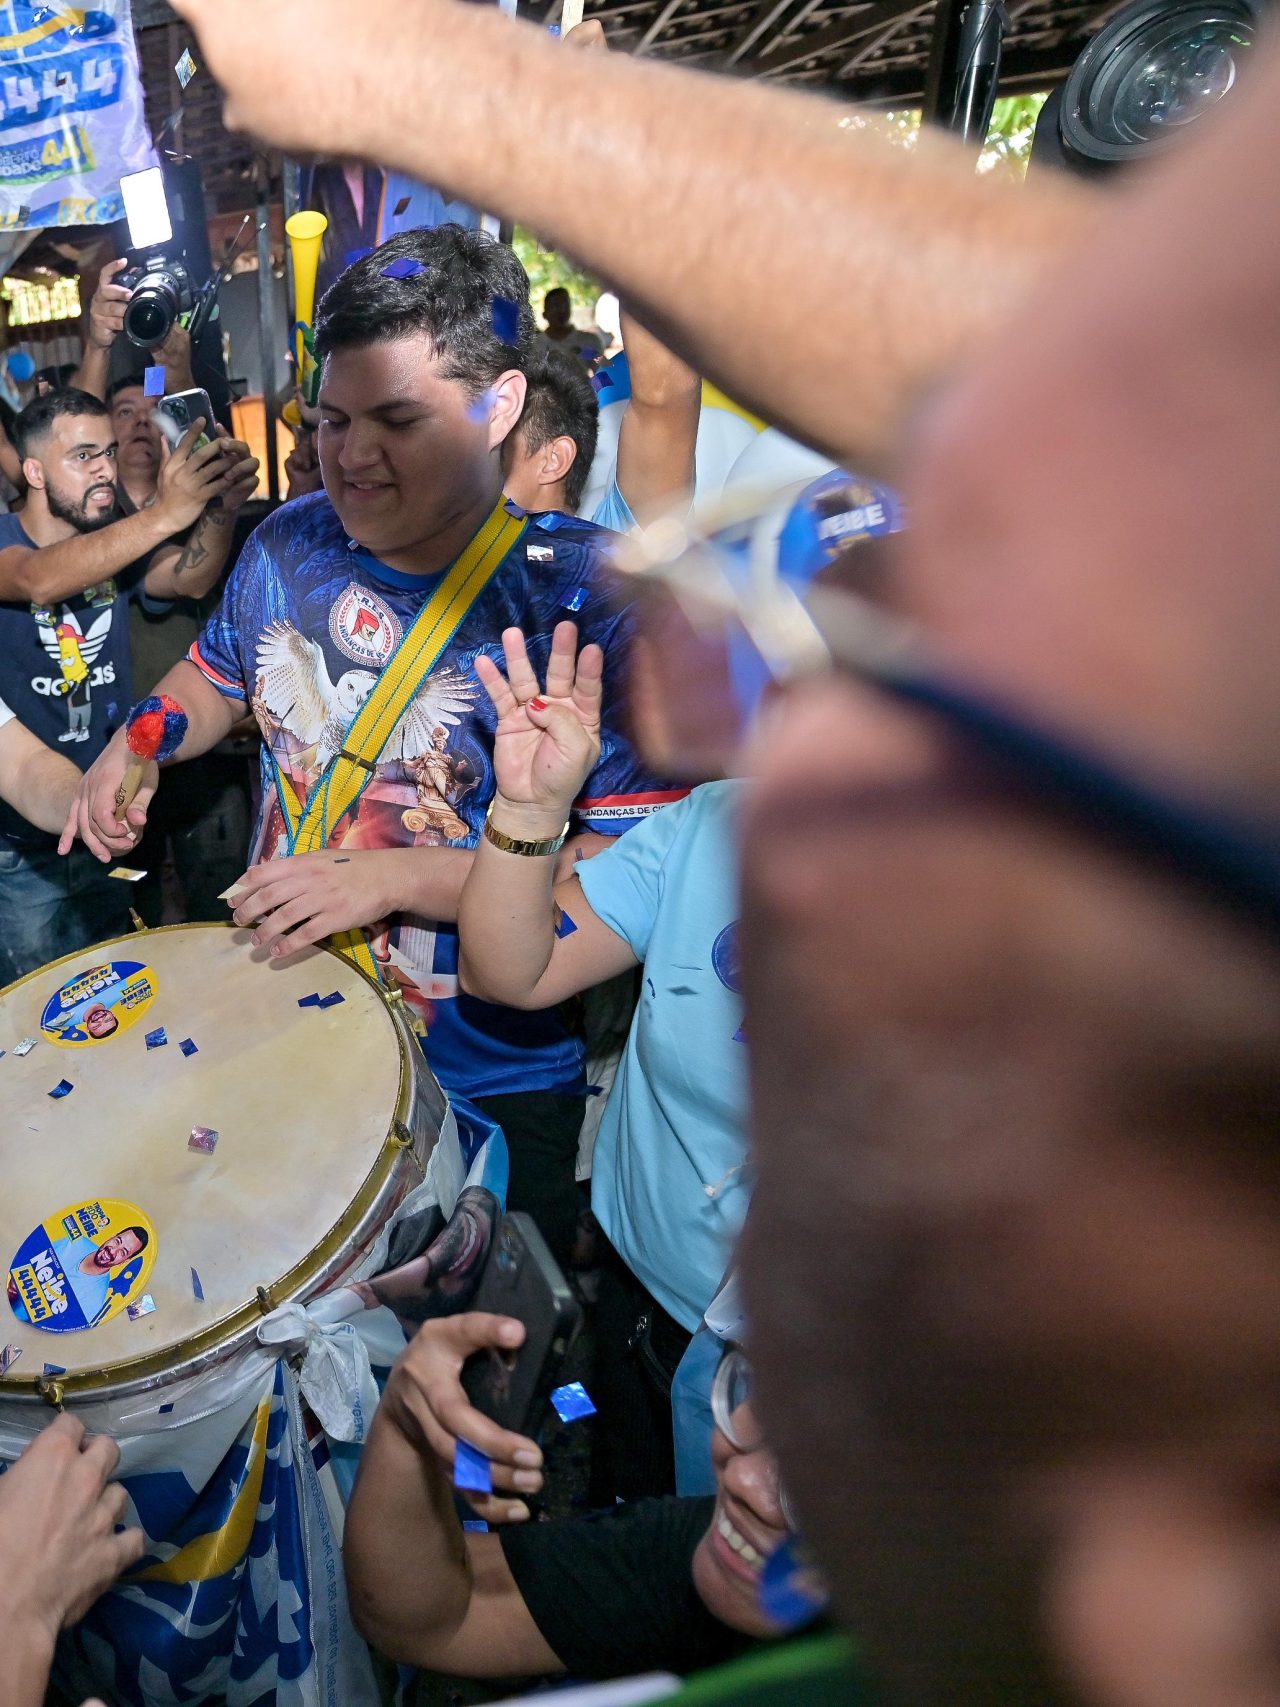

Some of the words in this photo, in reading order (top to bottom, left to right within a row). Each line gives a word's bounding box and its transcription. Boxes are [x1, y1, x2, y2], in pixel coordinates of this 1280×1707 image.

[584, 808, 635, 818] ANDANÇAS
[637, 807, 651, 815] DE
[74, 1206, 99, 1238] NEIBE
[92, 1201, 106, 1220] TROPA
[16, 1267, 48, 1320] 44444
[28, 1248, 68, 1315] Neibe
